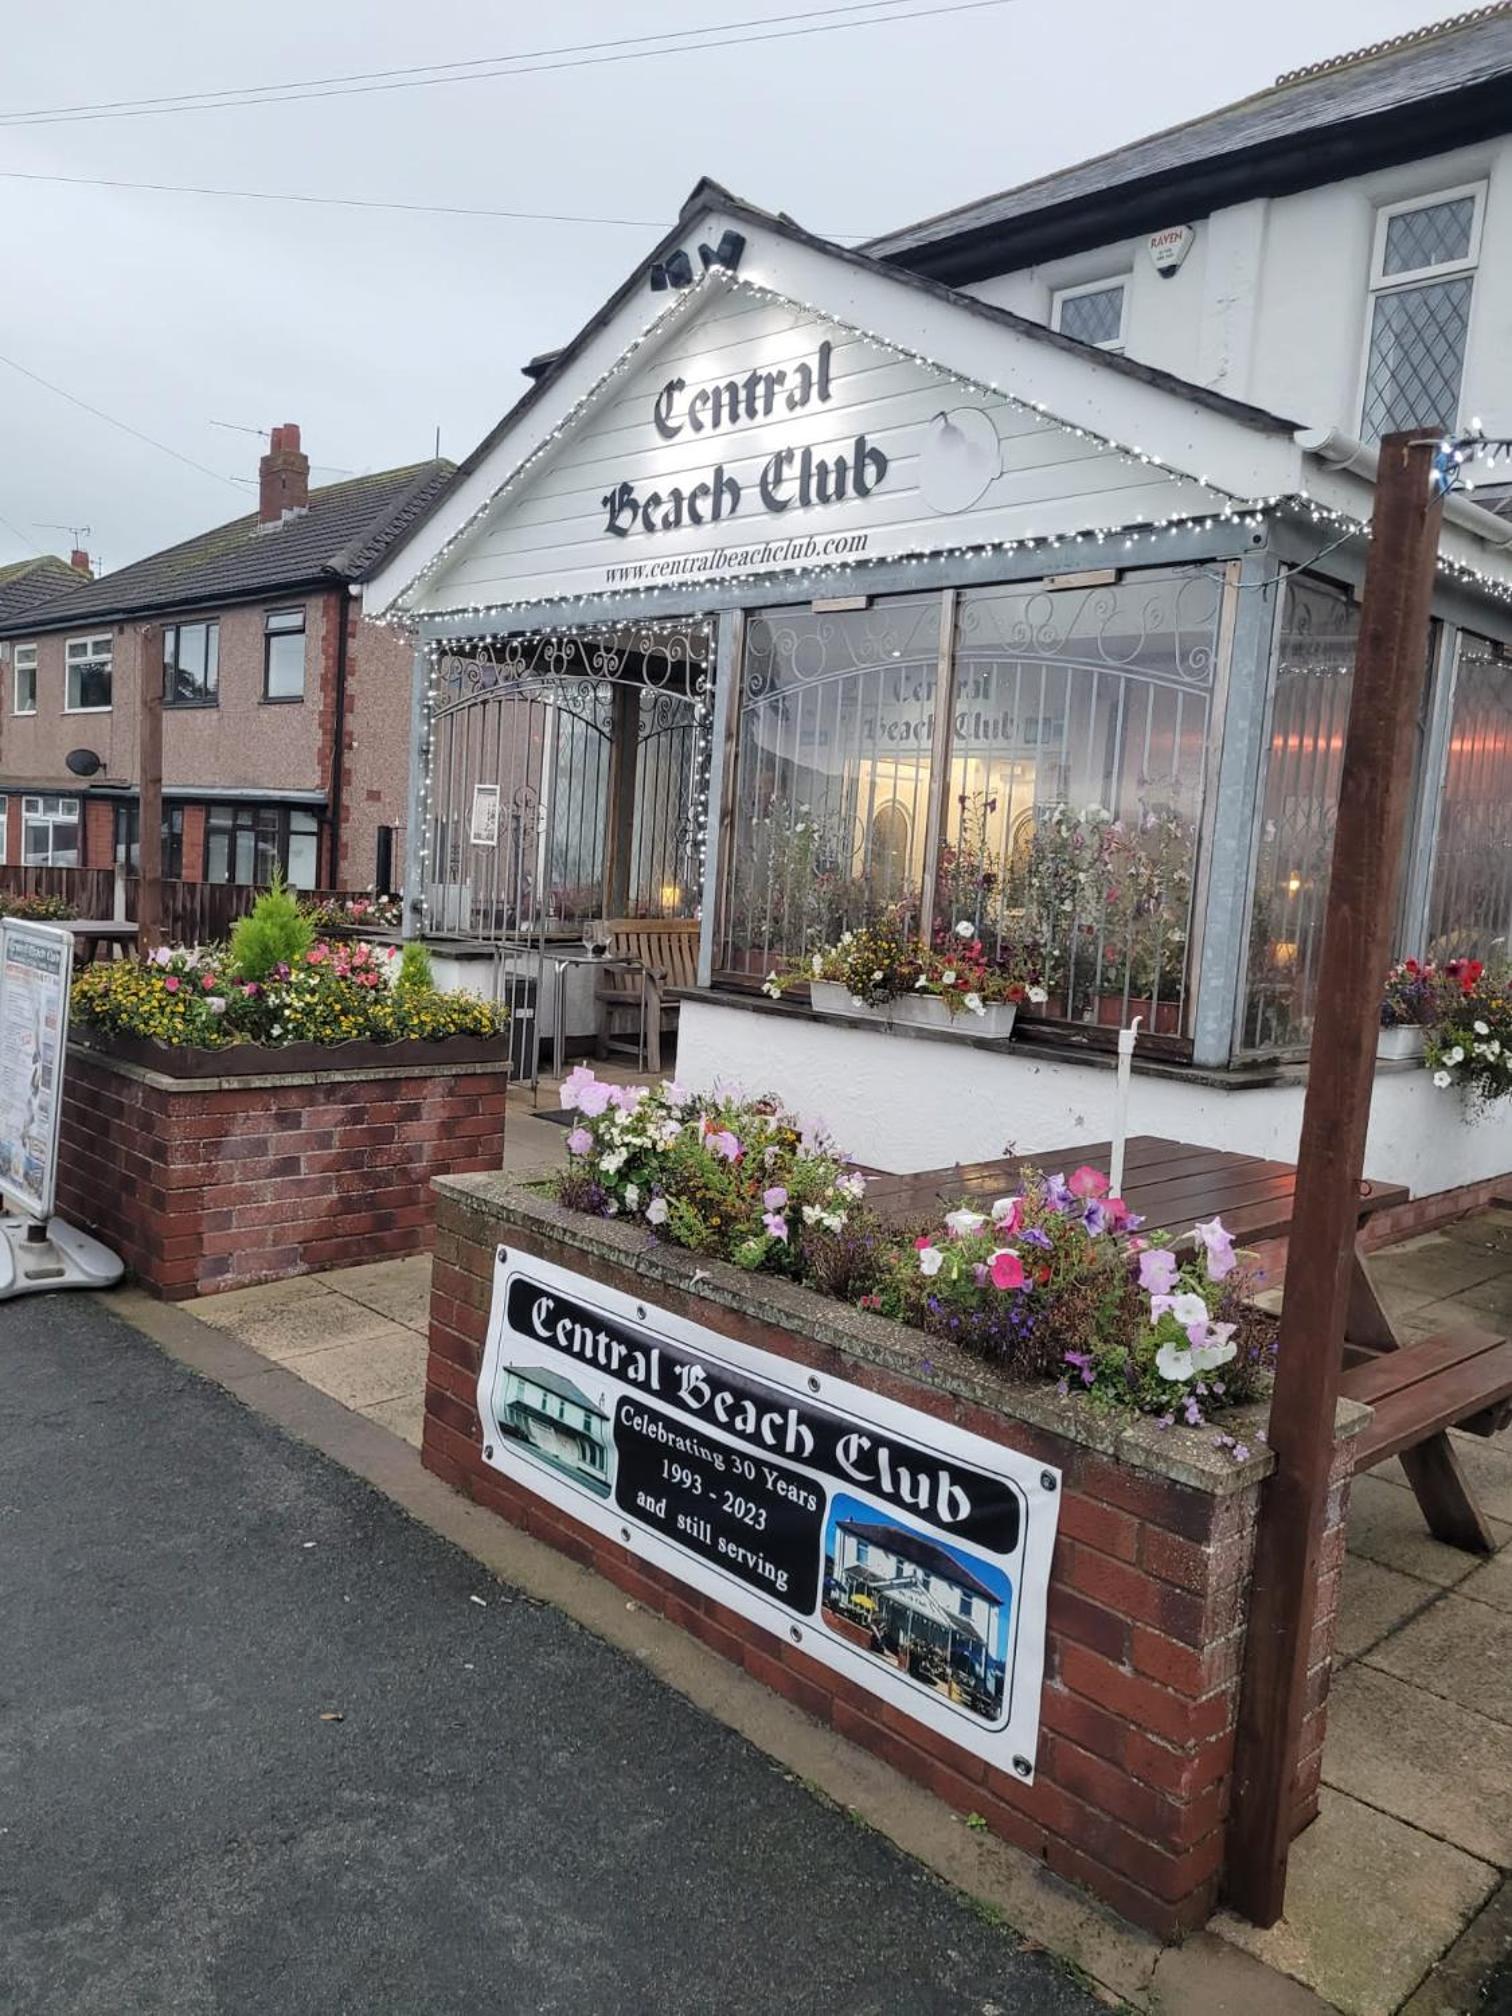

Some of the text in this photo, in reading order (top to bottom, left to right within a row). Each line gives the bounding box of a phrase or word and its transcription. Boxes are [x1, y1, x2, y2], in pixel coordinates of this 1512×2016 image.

[1151, 229, 1184, 249] RAVEN
[653, 340, 832, 439] Central
[601, 434, 888, 538] Beach Club
[605, 532, 869, 584] www.centralbeachclub.com
[531, 1296, 972, 1523] Central Beach Club
[620, 1405, 818, 1512] Celebrating 30 Years
[636, 1491, 789, 1592] and still serving
[661, 1459, 703, 1495] 1993
[722, 1490, 768, 1531] 2023
